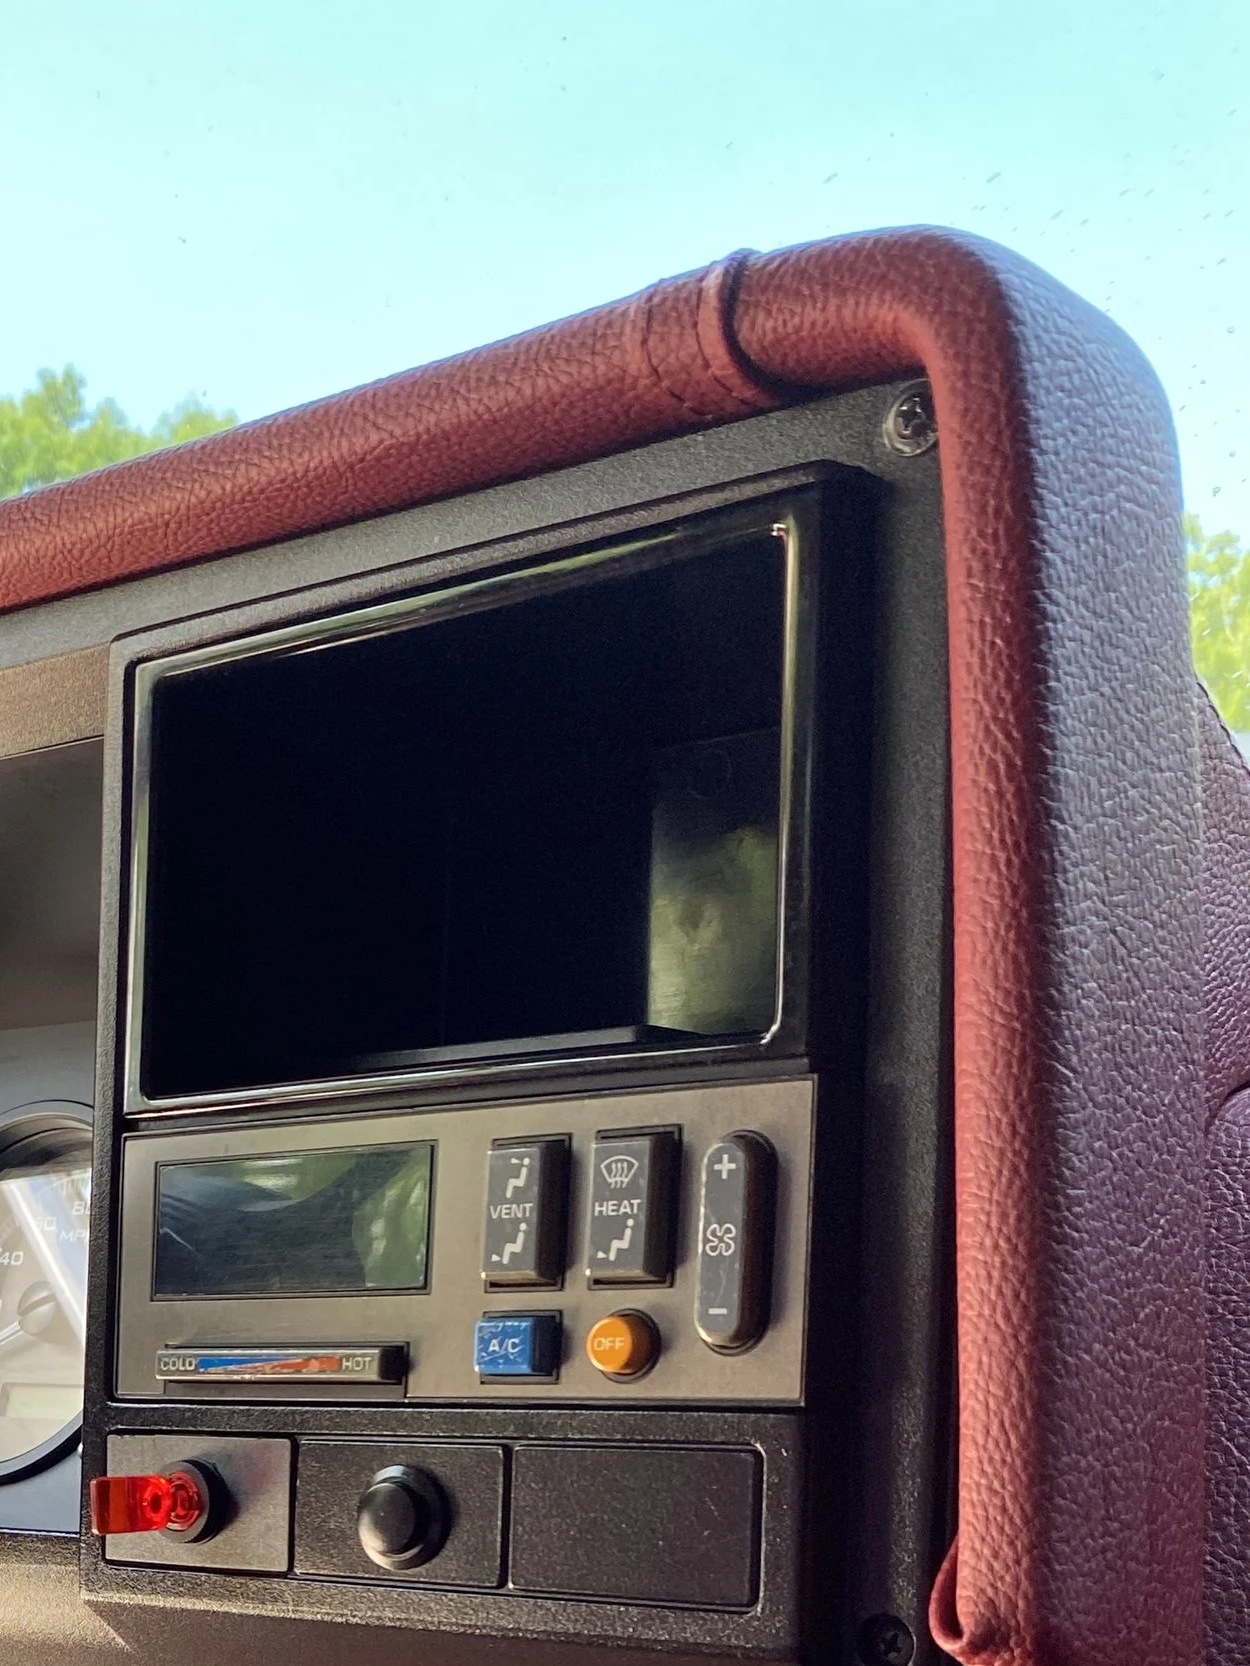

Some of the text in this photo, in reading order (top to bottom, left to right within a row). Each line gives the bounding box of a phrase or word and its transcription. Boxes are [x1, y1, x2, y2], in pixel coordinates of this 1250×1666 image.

[490, 1202, 533, 1220] VENT
[594, 1198, 641, 1217] HEAT
[60, 1229, 87, 1243] MP
[488, 1334, 521, 1356] A/C
[593, 1336, 625, 1353] OFF
[159, 1356, 196, 1373] COLD
[341, 1354, 372, 1373] HOT
